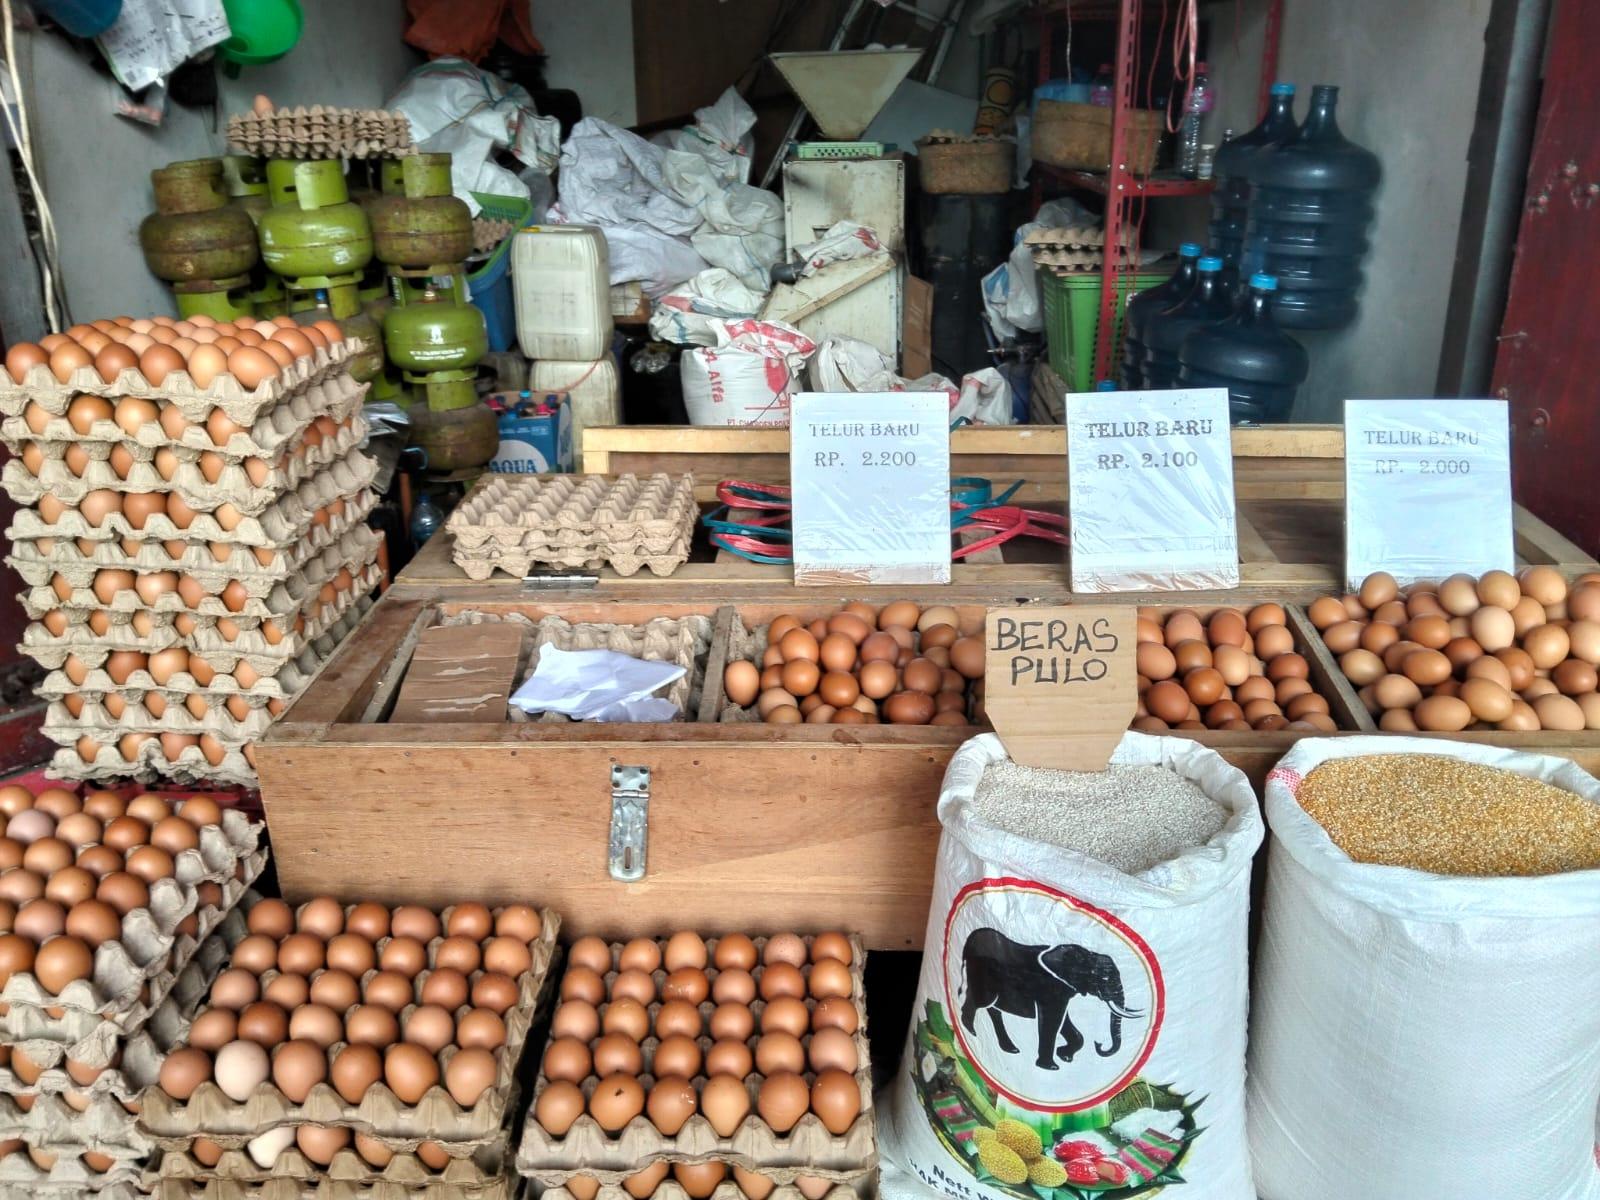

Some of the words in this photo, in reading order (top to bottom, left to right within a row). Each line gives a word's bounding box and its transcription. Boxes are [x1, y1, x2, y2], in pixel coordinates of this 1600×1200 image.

[708, 370, 725, 404] Alfa
[808, 423, 865, 437] TELUR
[870, 423, 920, 437] BARU
[1085, 421, 1151, 438] TELUR
[1155, 419, 1213, 436] BARU
[1363, 430, 1422, 446] TELUR
[1428, 430, 1479, 446] BARU
[490, 460, 538, 474] AQUA
[815, 451, 844, 467] RP.
[862, 451, 916, 466] 2.200
[1097, 453, 1130, 470] RP.
[1142, 451, 1198, 468] 2.100
[1375, 459, 1404, 475] RP.
[1419, 459, 1470, 475] 2.000
[991, 617, 1118, 654] BERAS
[1011, 656, 1107, 686] PULO
[932, 1164, 971, 1197] Nett
